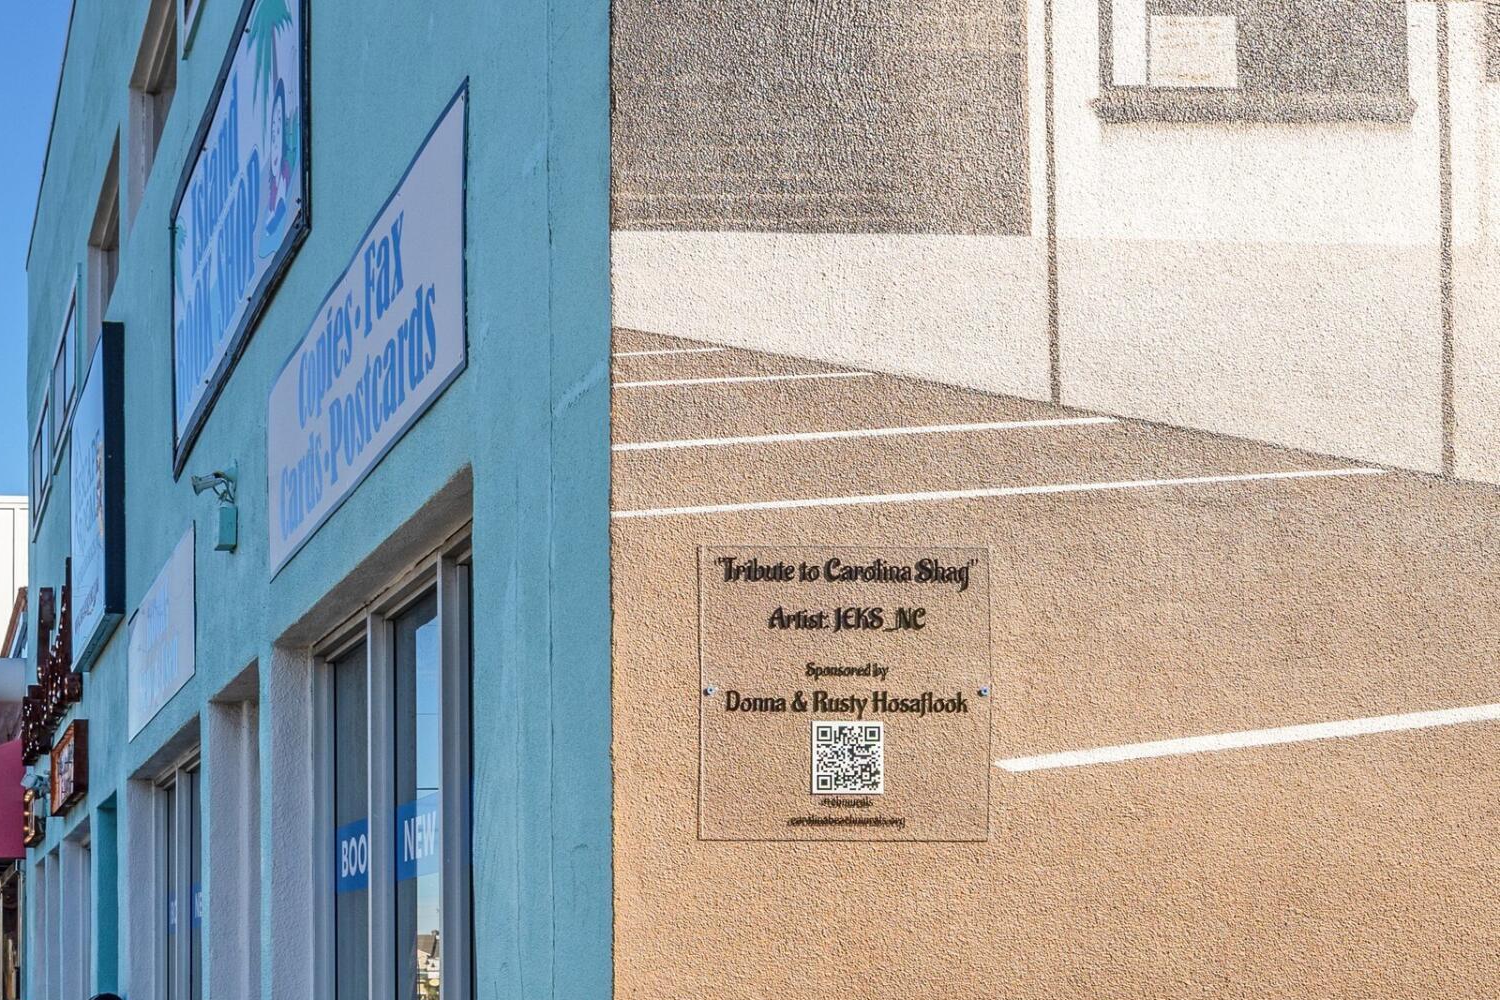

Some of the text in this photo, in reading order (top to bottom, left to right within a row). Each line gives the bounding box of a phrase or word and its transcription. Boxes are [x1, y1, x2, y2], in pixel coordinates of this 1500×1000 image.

[190, 71, 239, 277] Island
[175, 147, 261, 422] BOOK SHOP
[299, 210, 405, 430] Copies Fax
[279, 282, 437, 542] Cards Postcards
[799, 560, 820, 583] to
[823, 557, 912, 583] Carolina
[768, 605, 829, 630] Artist:
[805, 661, 890, 681] Sponsored by
[725, 691, 969, 720] Donna & Rusty Hosaflook
[341, 811, 437, 878] BOO NEW
